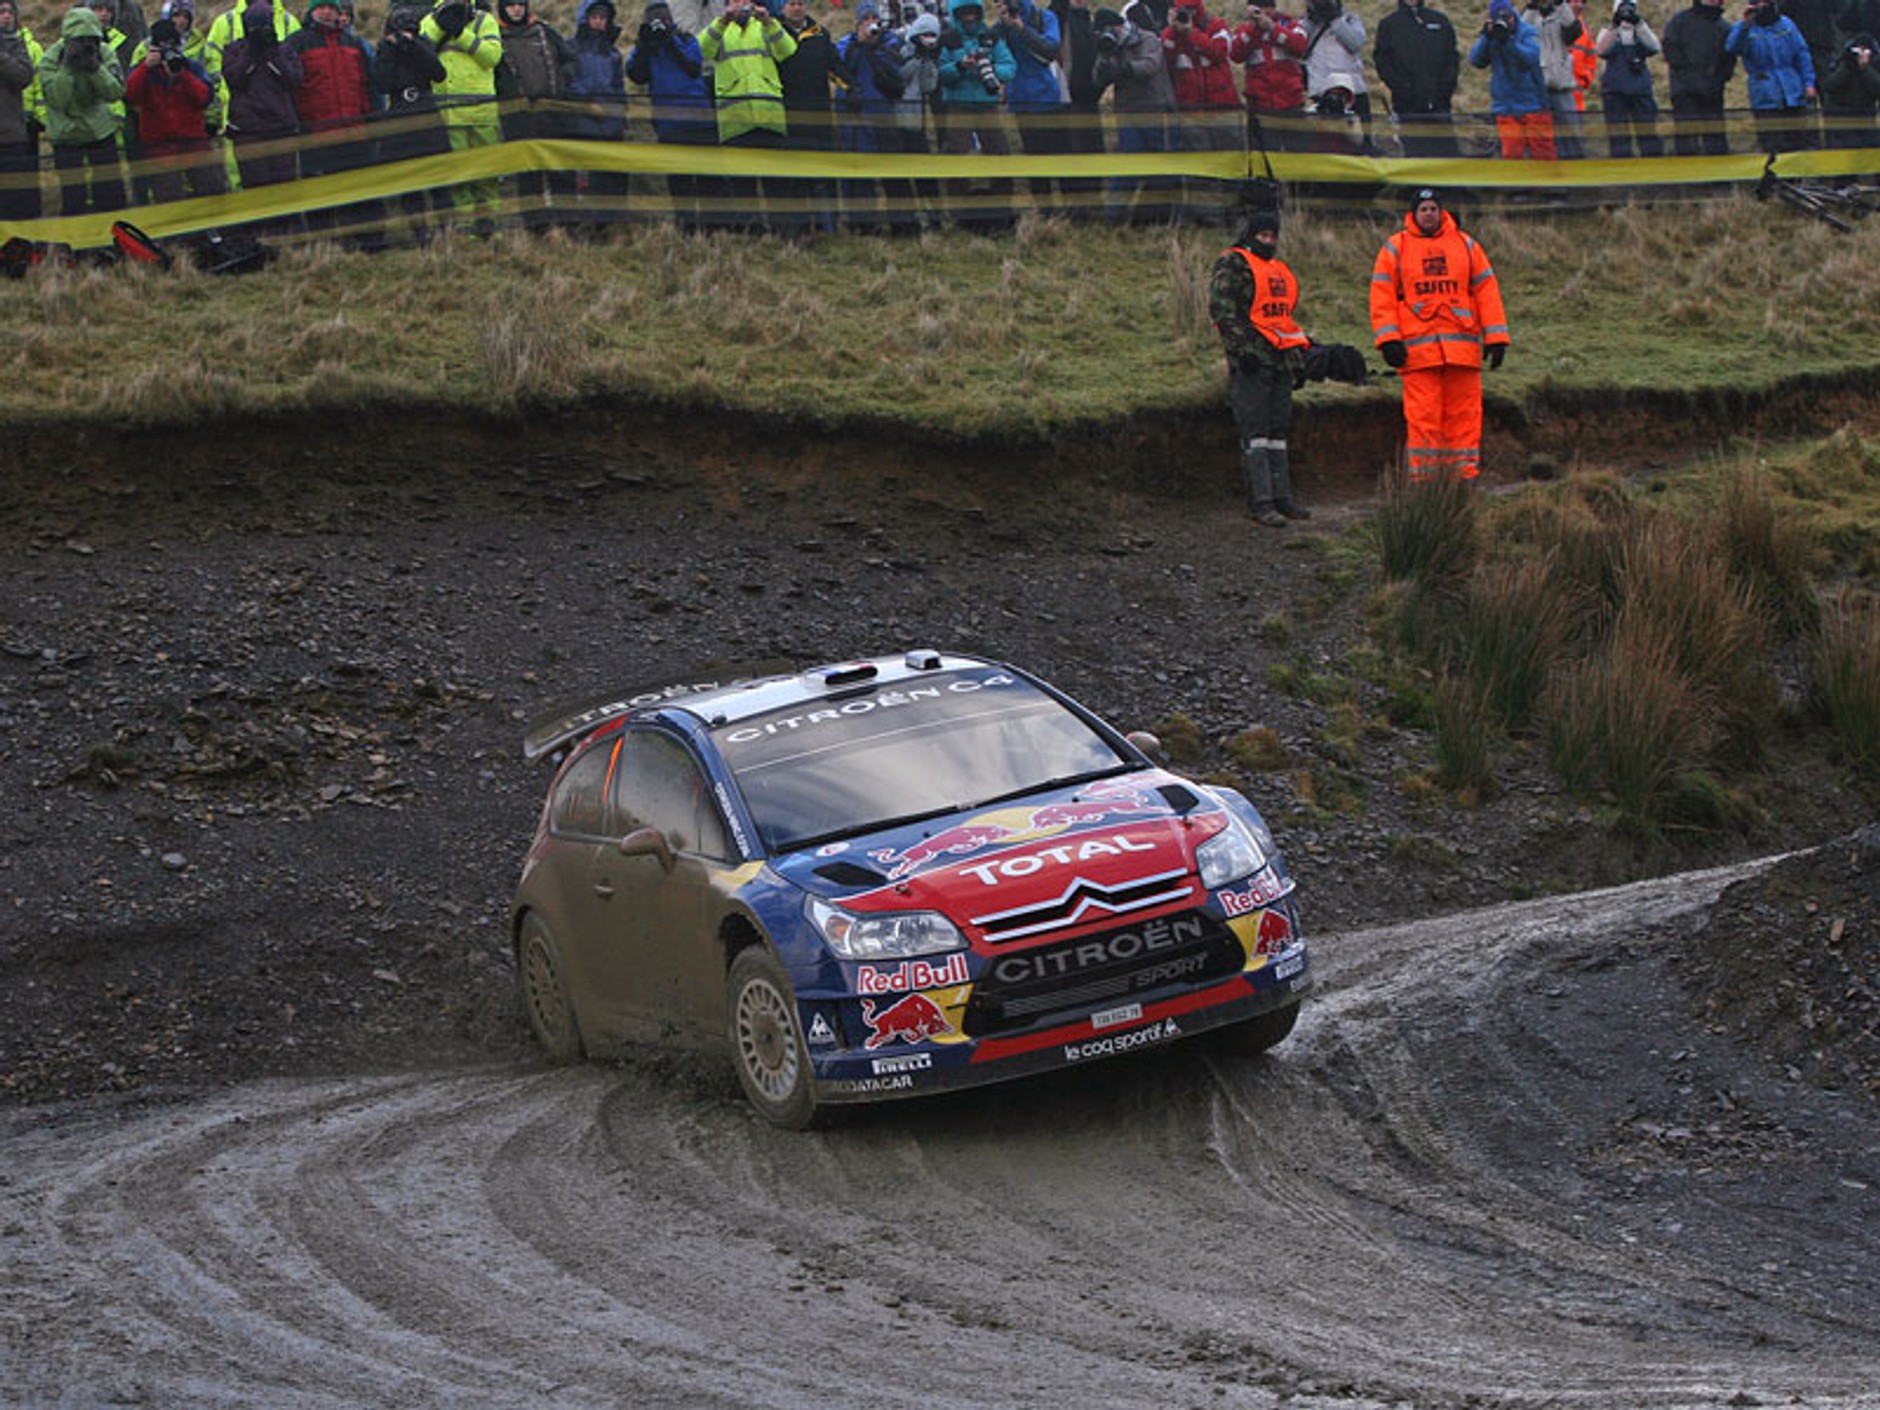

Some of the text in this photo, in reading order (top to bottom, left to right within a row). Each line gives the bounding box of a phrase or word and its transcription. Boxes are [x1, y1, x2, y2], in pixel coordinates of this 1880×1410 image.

[1415, 280, 1458, 294] SAFETY
[726, 673, 1014, 742] CITROËN C4
[959, 834, 1156, 886] TOTAL
[995, 917, 1203, 982] CITROËN
[858, 953, 969, 995] Red Bull
[1137, 952, 1209, 987] SPORT
[1065, 1023, 1162, 1060] le coq sportif
[871, 1053, 932, 1075] PIRELLI
